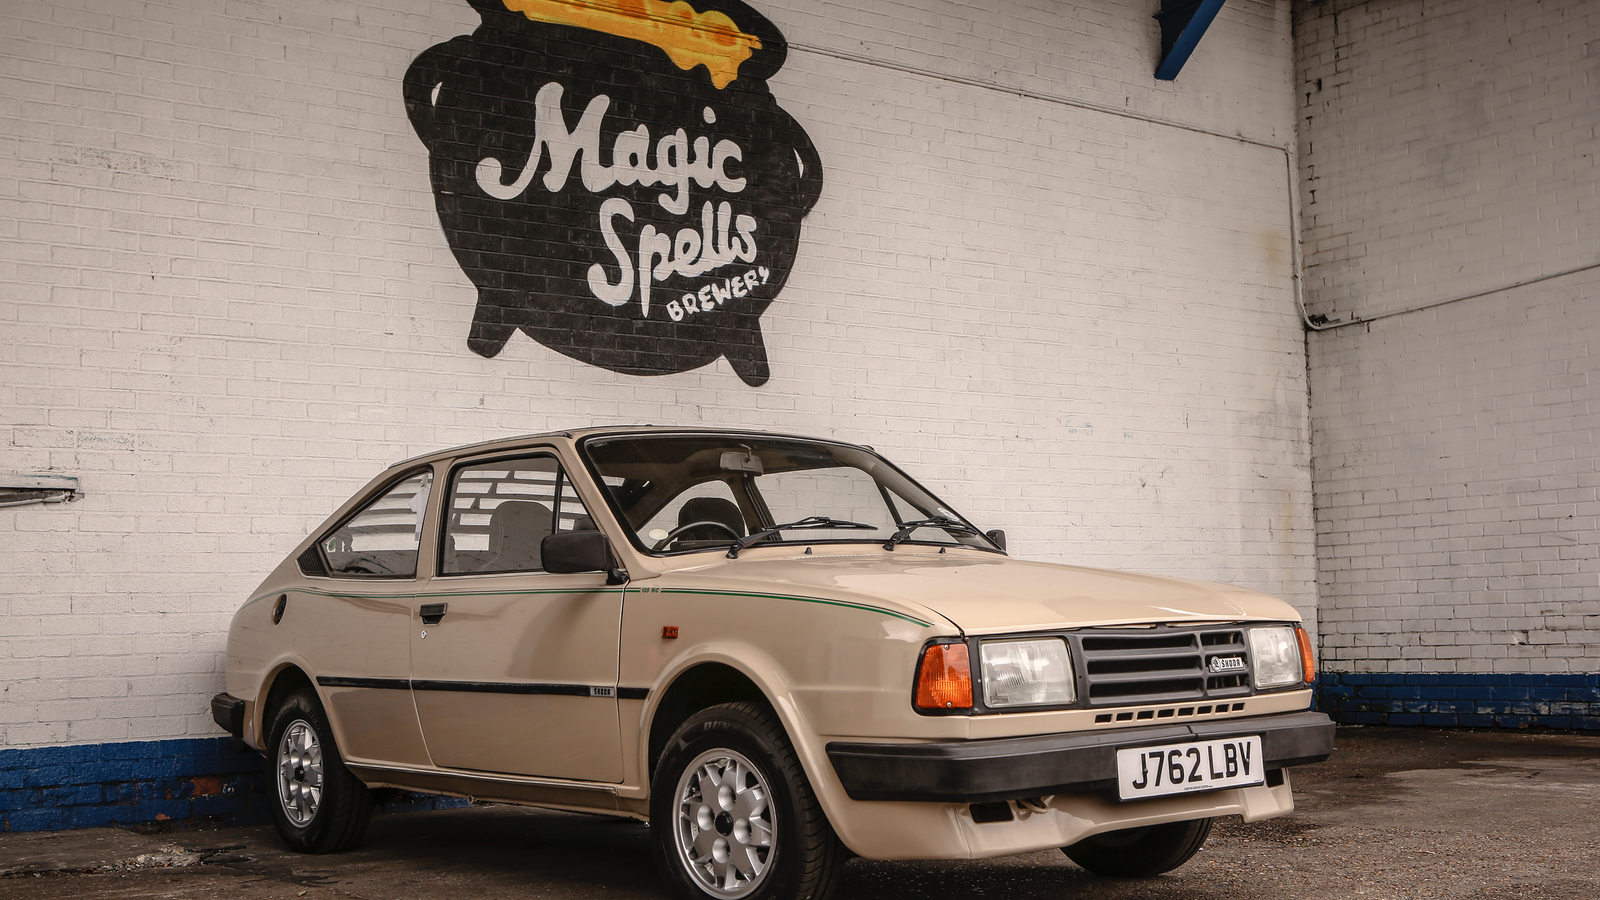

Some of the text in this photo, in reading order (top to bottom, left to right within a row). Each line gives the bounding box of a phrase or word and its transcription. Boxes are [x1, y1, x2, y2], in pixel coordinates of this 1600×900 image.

[475, 81, 747, 215] Magic
[587, 198, 757, 318] Spells
[666, 266, 769, 321] BREWERY
[1132, 741, 1252, 790] J762 LBV
